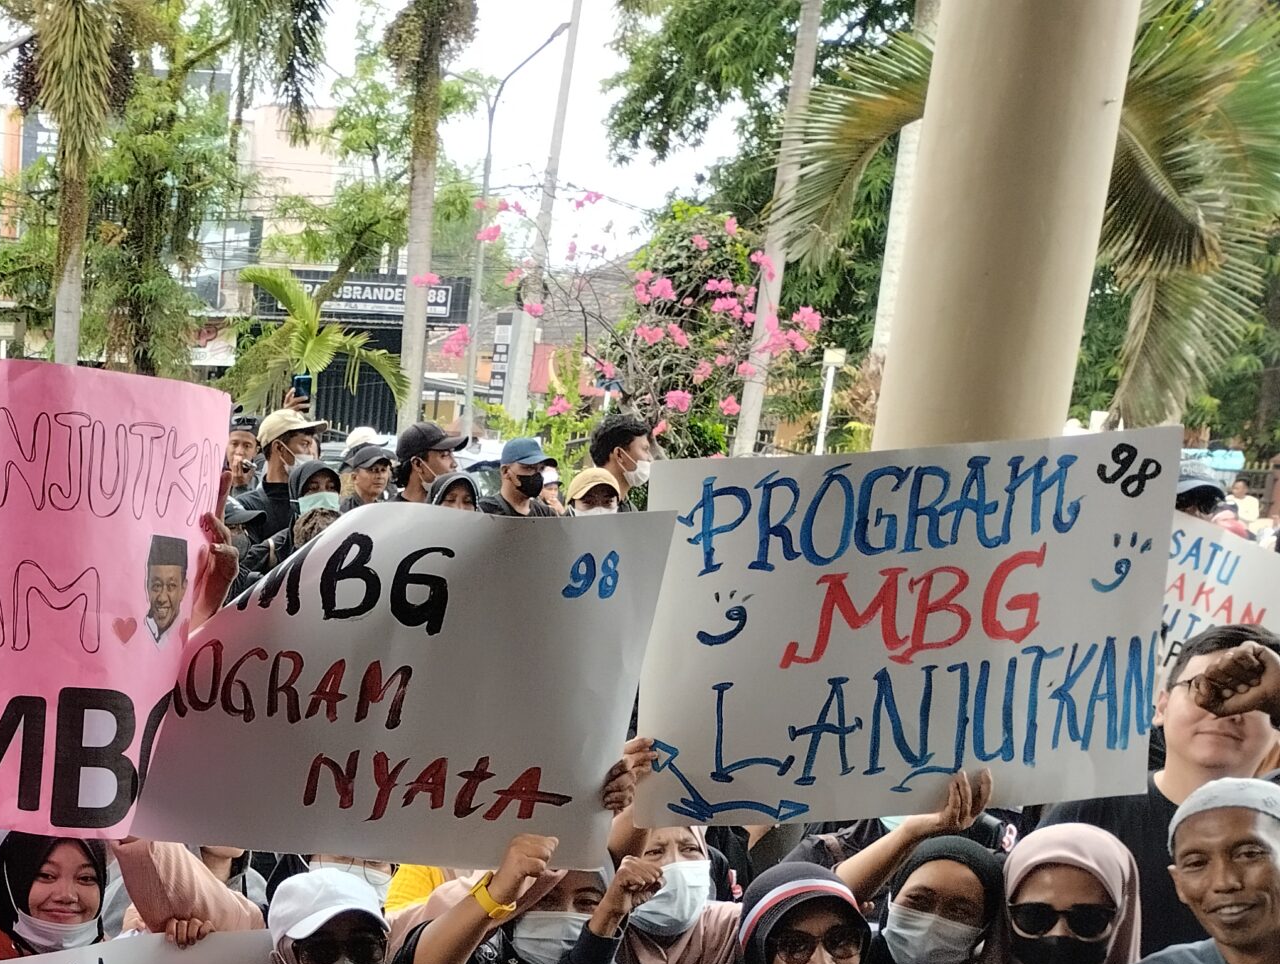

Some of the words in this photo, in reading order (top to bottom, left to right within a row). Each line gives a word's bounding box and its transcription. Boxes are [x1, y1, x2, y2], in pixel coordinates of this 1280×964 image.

[427, 289, 447, 303] 88
[1097, 443, 1162, 498] 98
[678, 455, 1087, 577] PROGRAM
[561, 549, 621, 600] 98
[1169, 528, 1241, 586] SATU
[779, 543, 1049, 670] MBG
[710, 627, 1159, 793] LANJUTKAN
